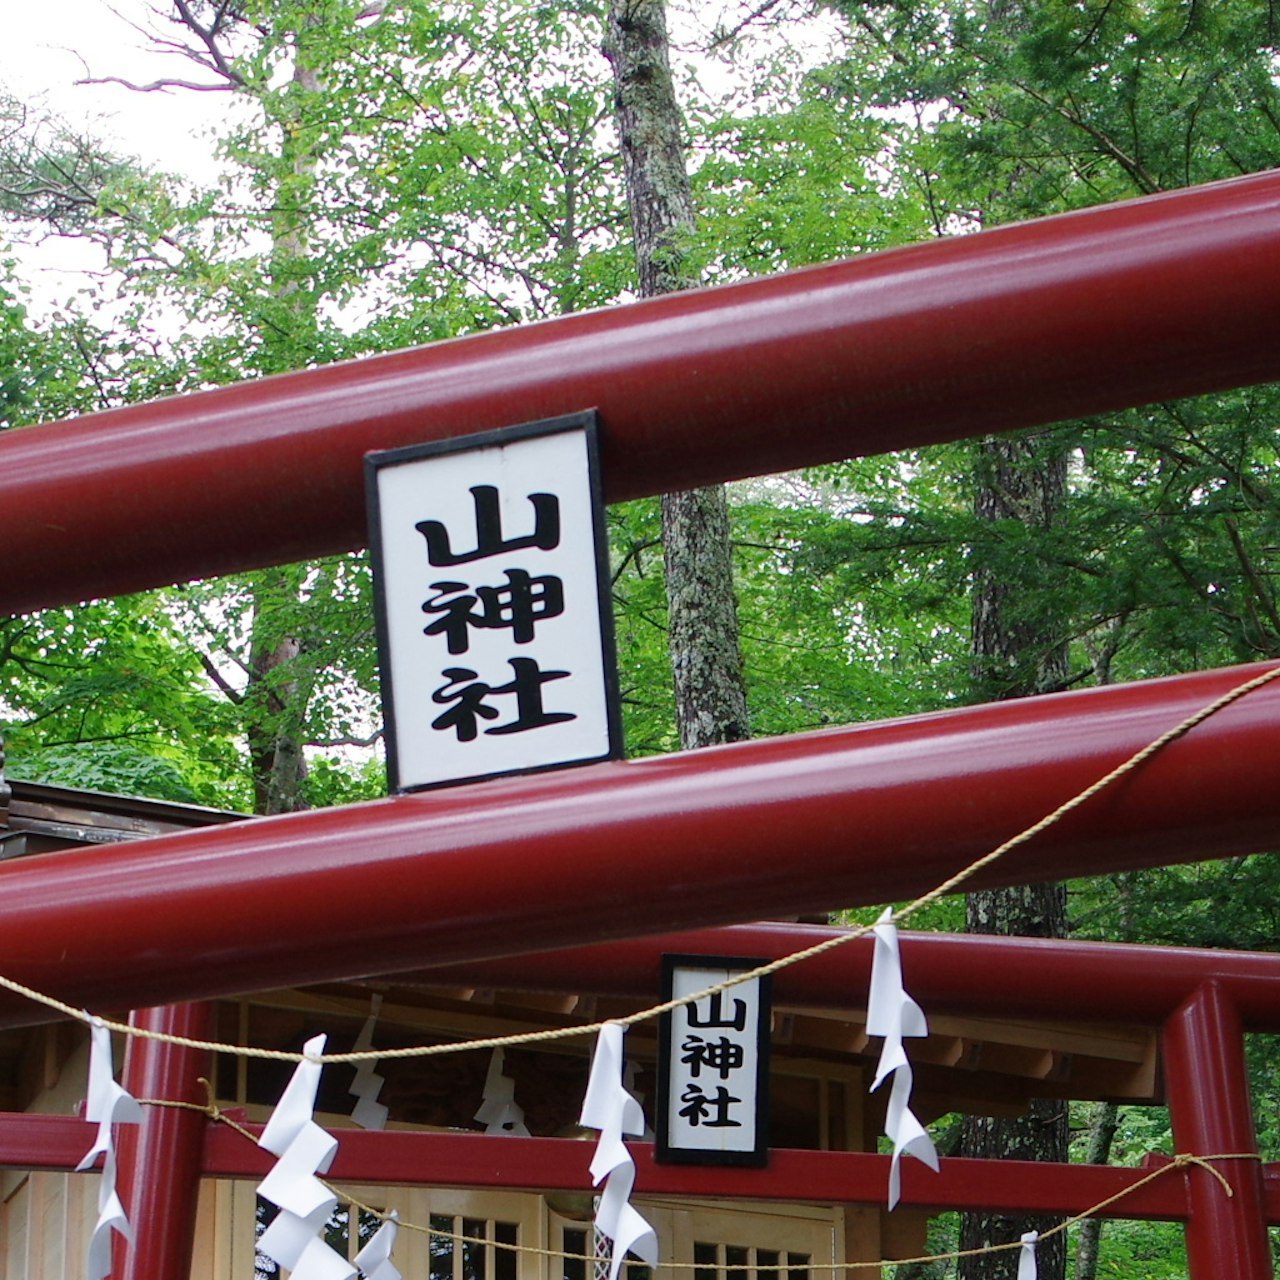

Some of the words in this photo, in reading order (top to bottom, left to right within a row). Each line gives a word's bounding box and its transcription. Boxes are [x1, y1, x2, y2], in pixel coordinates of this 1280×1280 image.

[415, 485, 578, 743] 山神社
[679, 986, 747, 1127] 山神社
